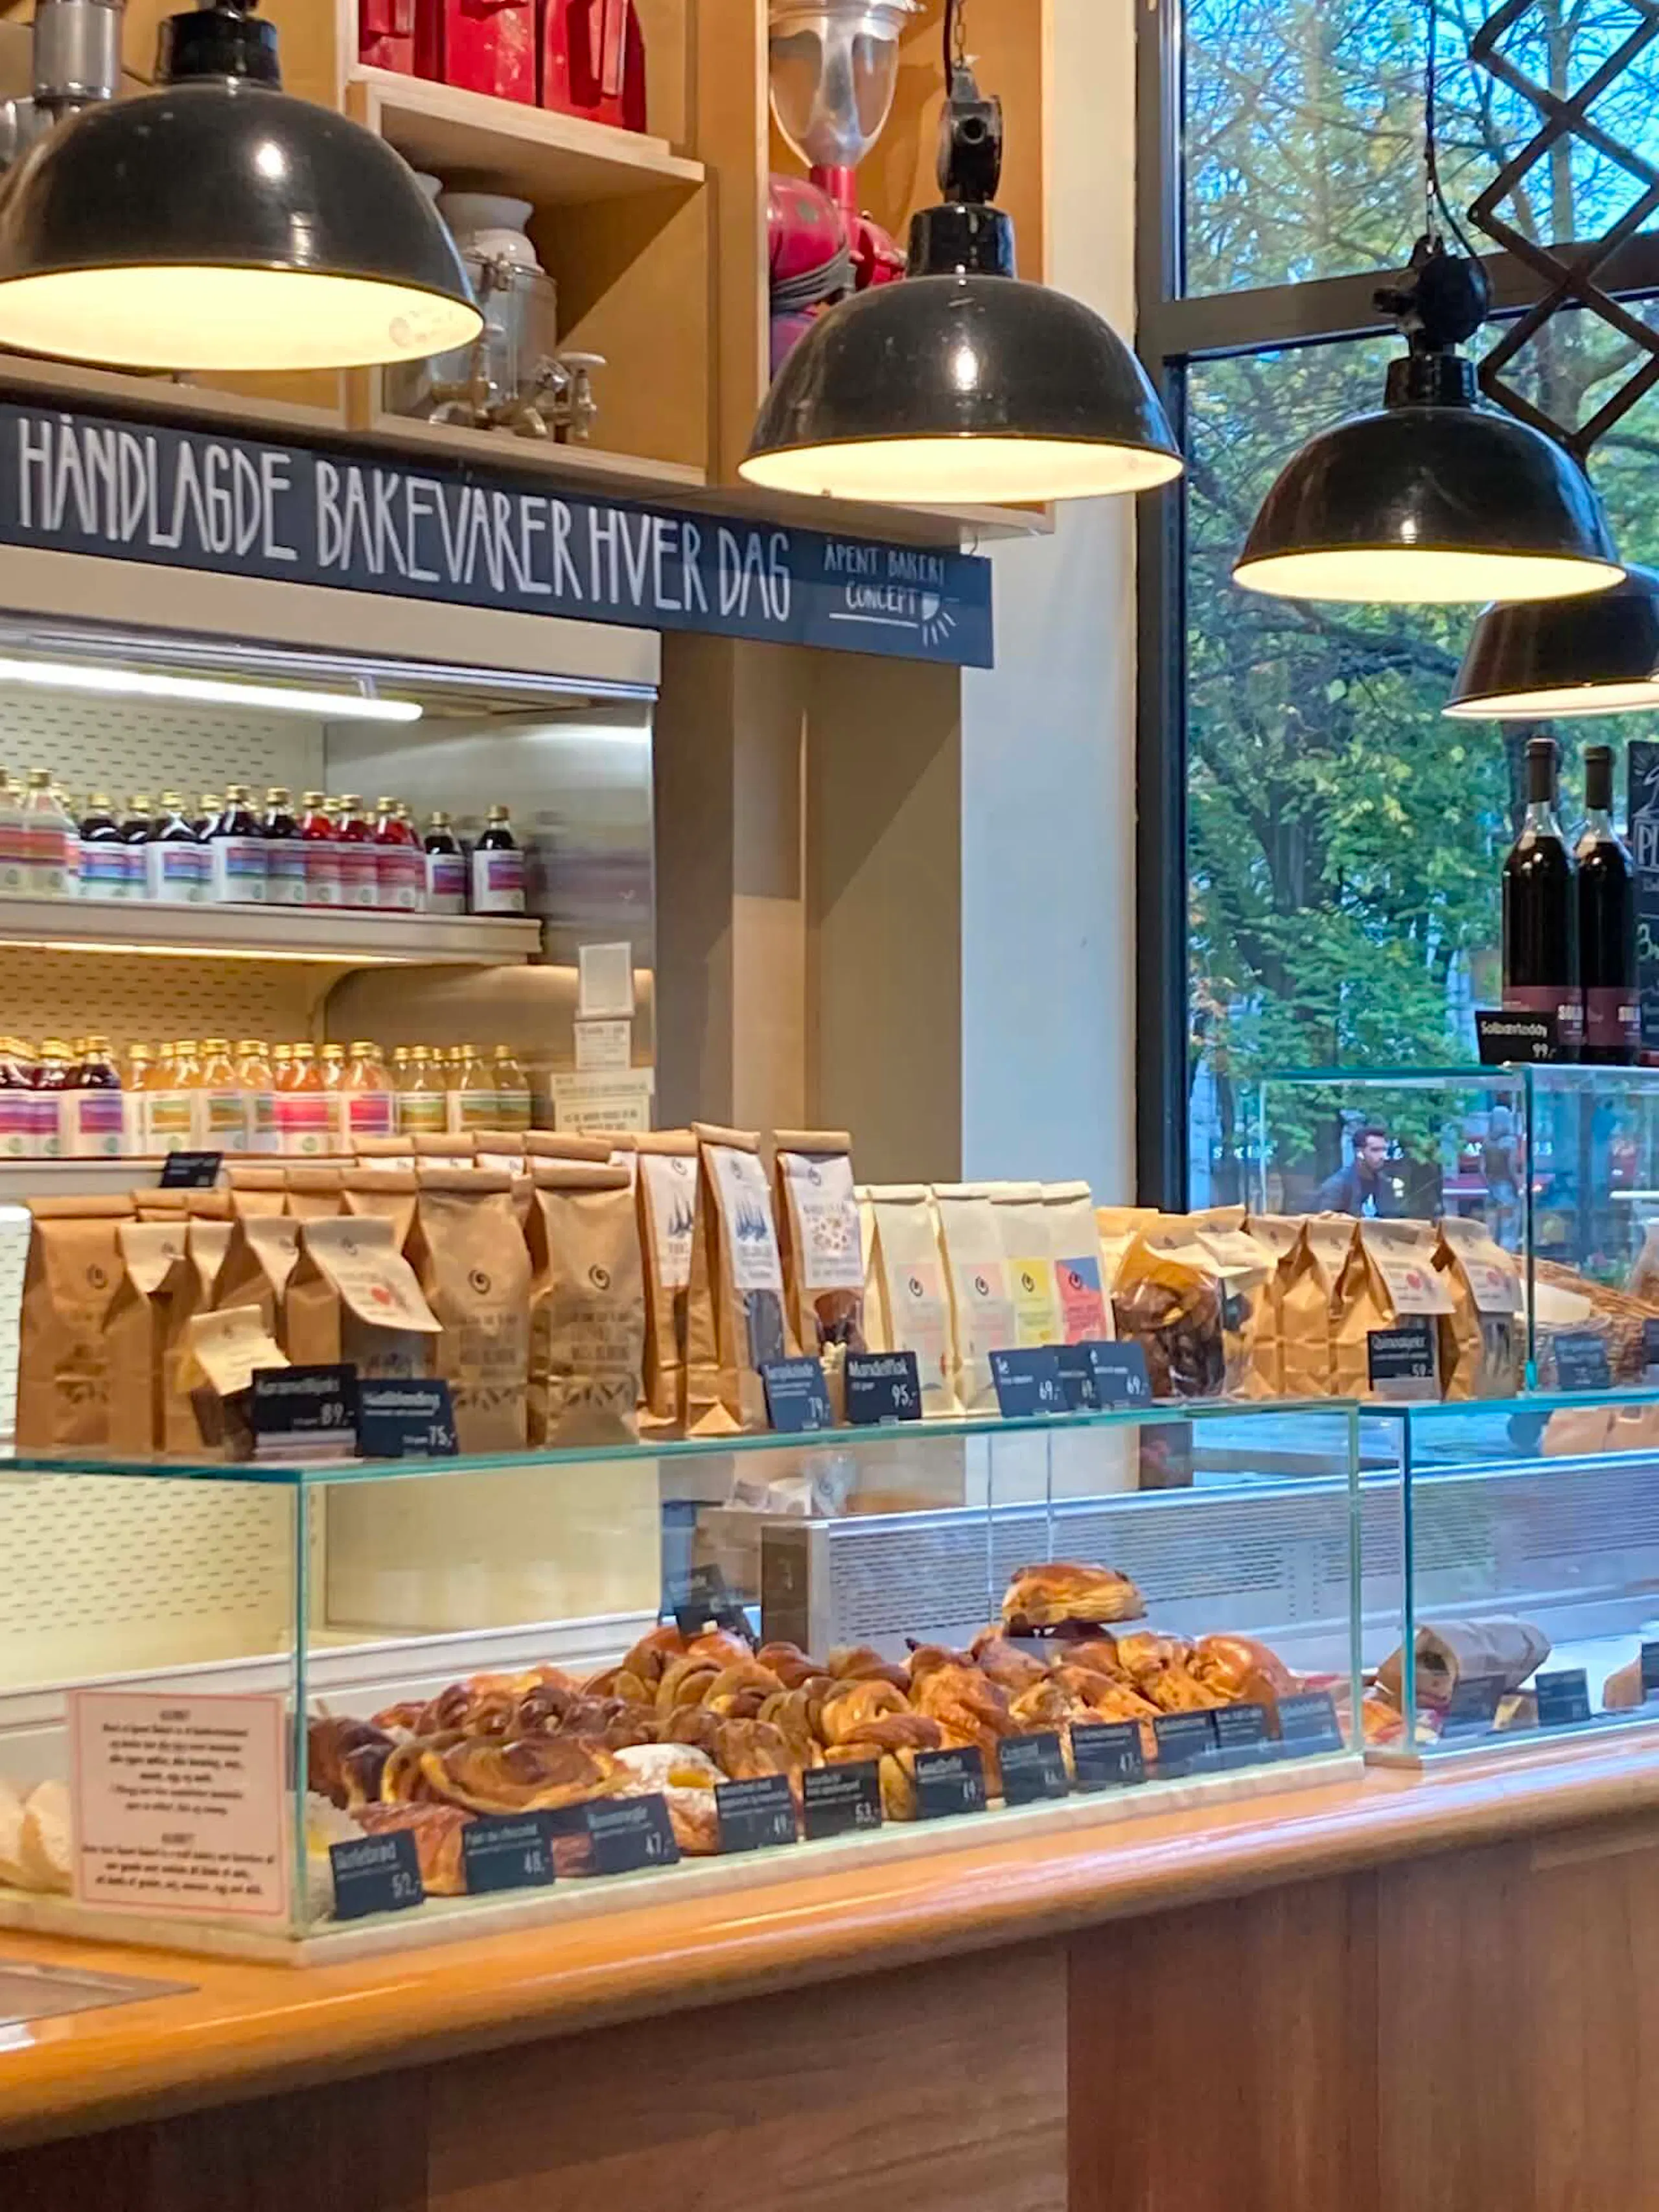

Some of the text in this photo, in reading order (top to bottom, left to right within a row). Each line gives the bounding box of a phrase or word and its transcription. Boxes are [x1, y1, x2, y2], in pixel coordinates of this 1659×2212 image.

[19, 414, 791, 622] HÅNDLAGDE BAKEVARER HVER DAG
[824, 537, 945, 586] ÅPENT BAKERI
[845, 580, 919, 615] CONCEPT
[891, 1383, 918, 1408] 95,-
